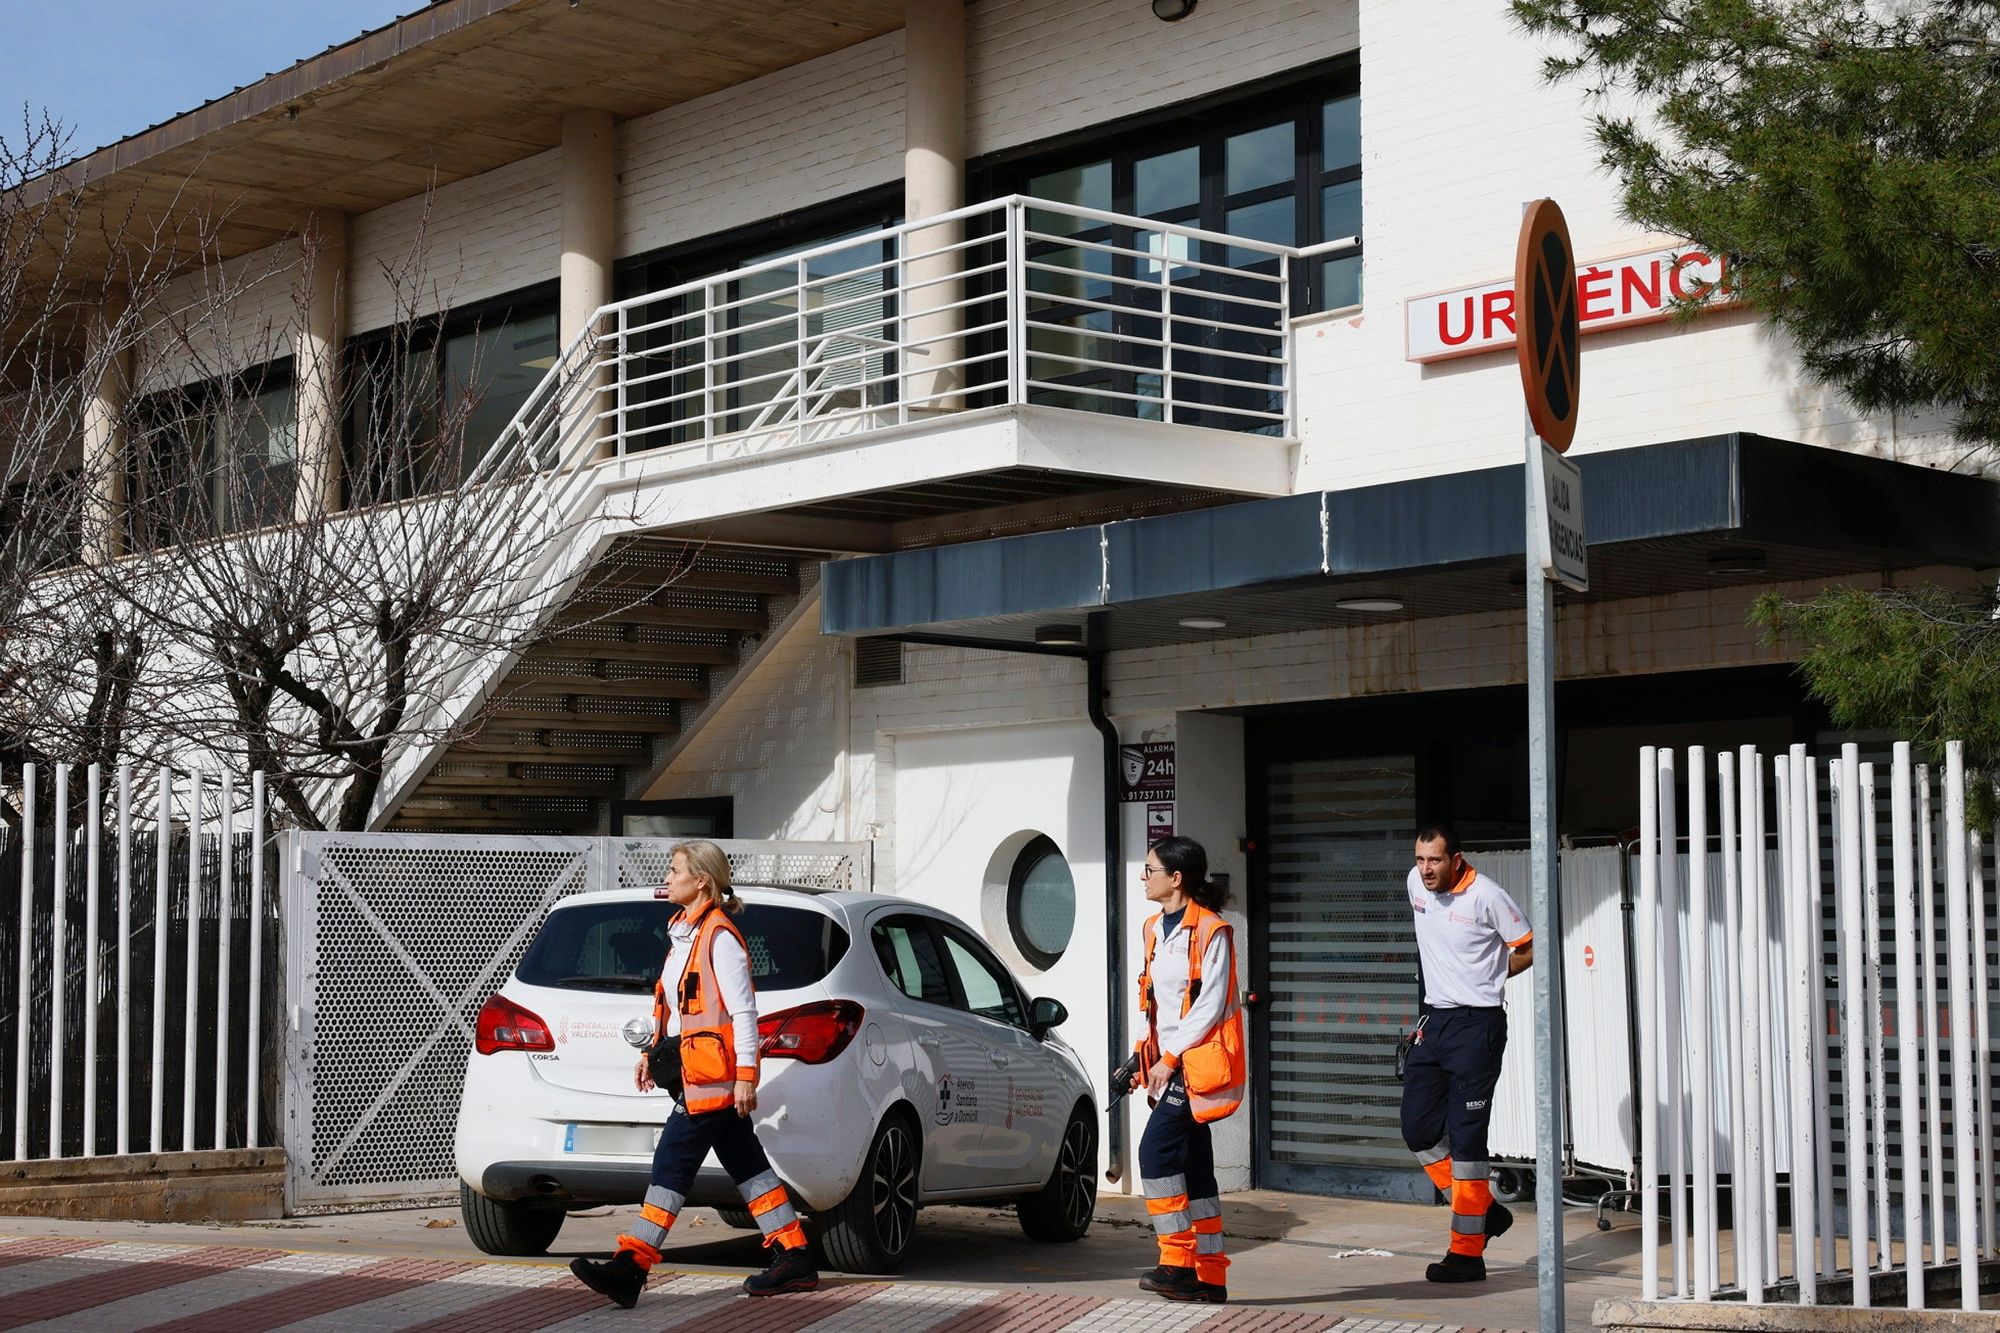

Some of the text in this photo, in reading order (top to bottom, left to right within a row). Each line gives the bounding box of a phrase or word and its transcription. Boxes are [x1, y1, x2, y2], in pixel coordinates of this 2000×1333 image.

[1438, 252, 1746, 346] URÈNCI
[1143, 745, 1175, 754] ALARMA
[1147, 758, 1174, 776] 24h
[1128, 789, 1175, 801] 91 737 11 71
[571, 1022, 621, 1030] GENERALITAT
[571, 1031, 619, 1039] VALENCIANA
